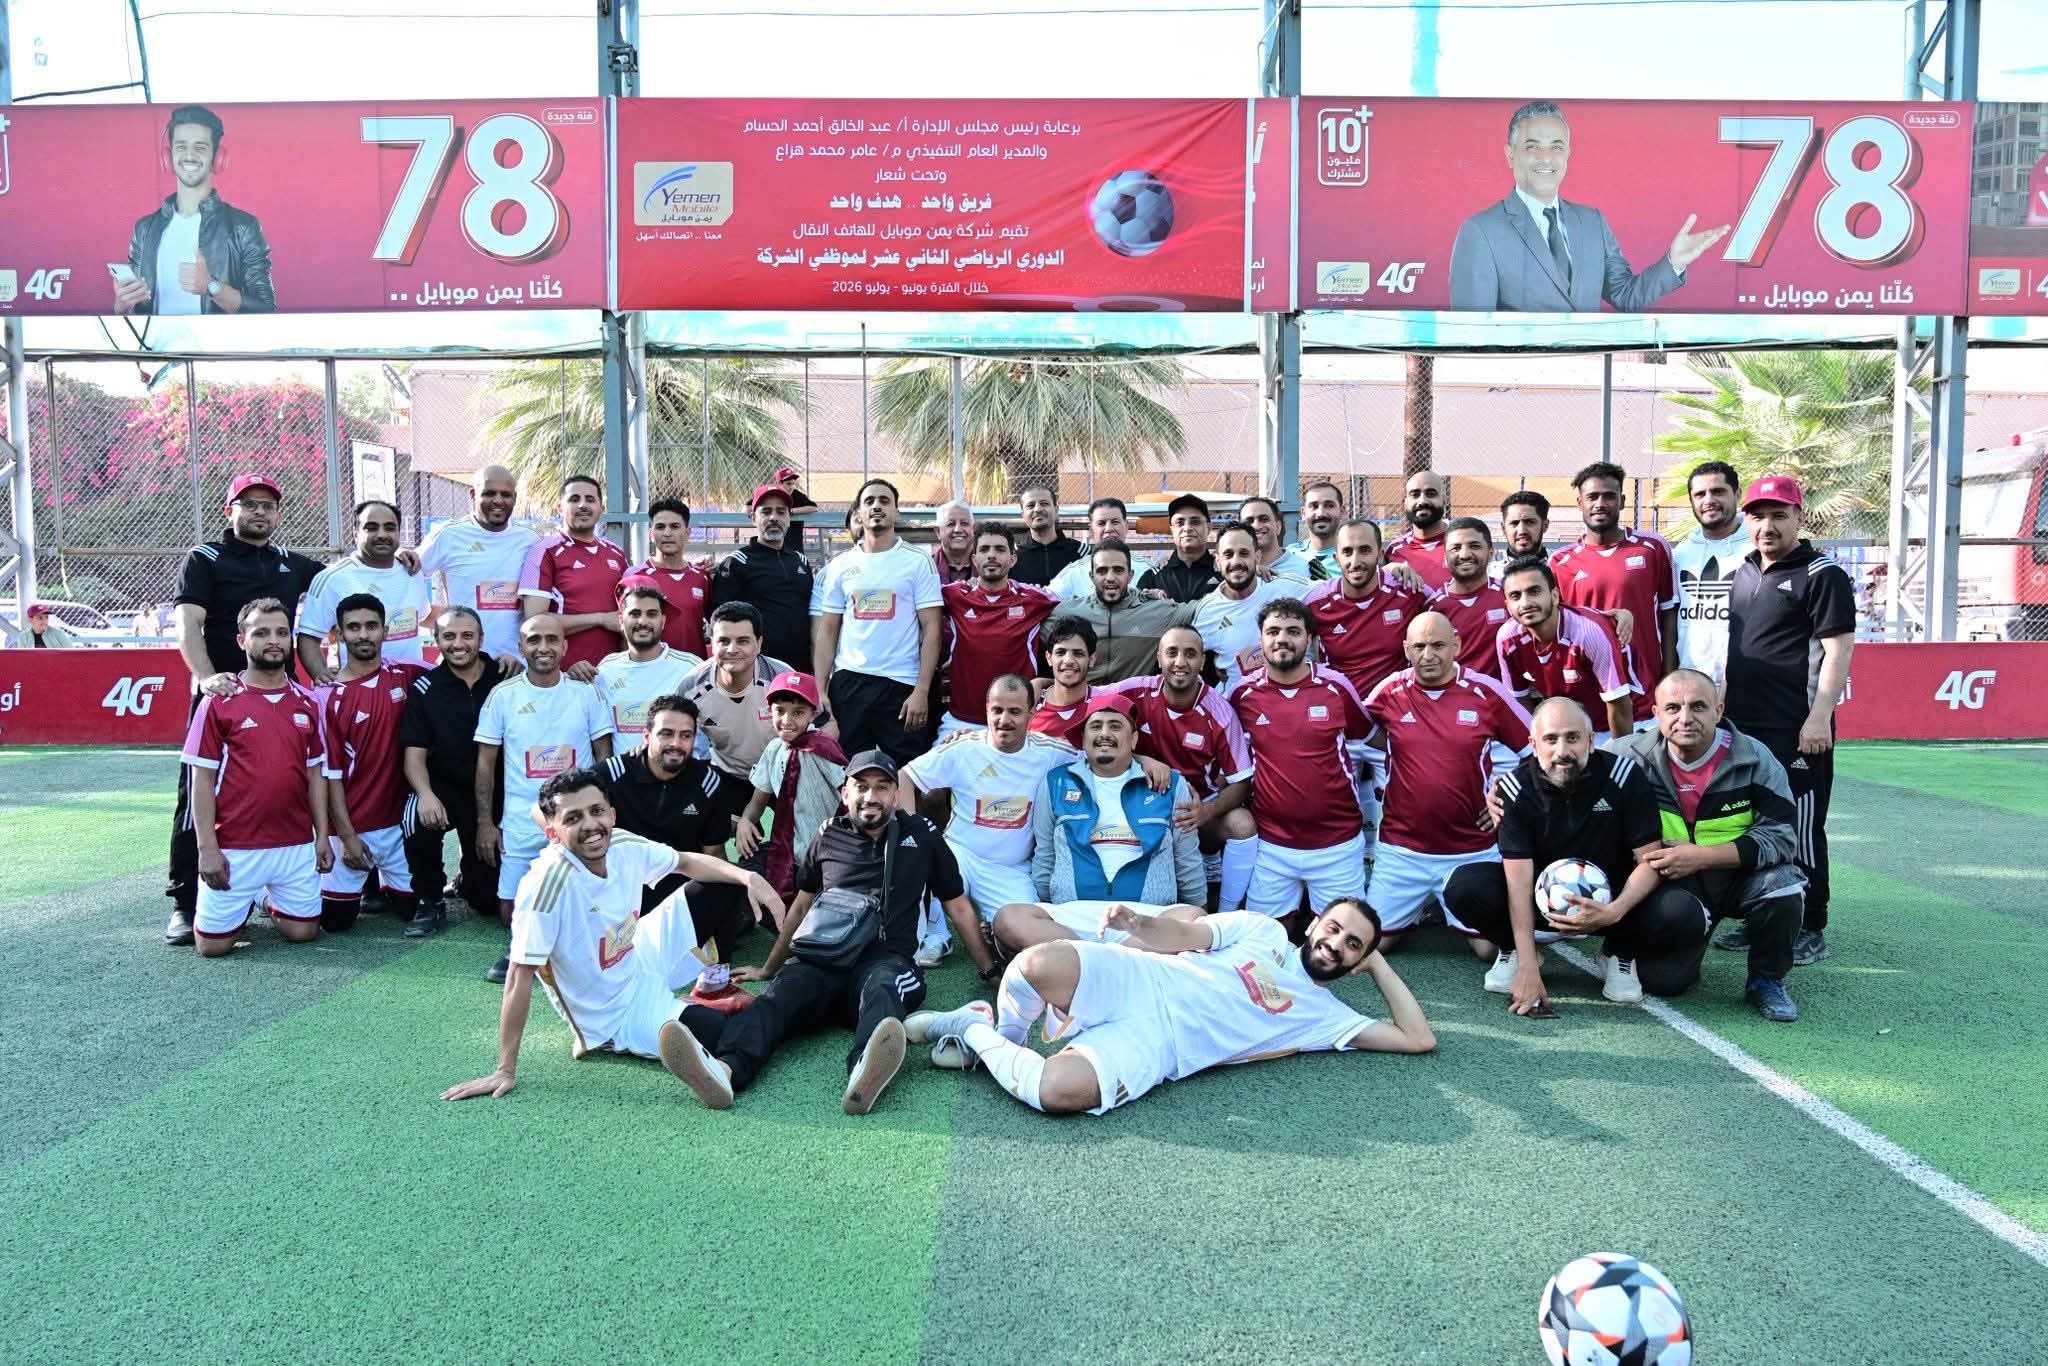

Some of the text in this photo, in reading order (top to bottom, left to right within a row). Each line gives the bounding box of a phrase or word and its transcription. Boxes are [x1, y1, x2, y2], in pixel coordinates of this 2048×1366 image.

[547, 111, 575, 123] جديدة
[792, 116, 824, 132] أحمد
[1909, 114, 1937, 126] جديدة
[743, 119, 788, 133] الحسام
[828, 119, 864, 135] الخالق
[868, 122, 892, 135] عبد
[912, 119, 951, 136] الإدارة
[955, 120, 999, 136] مجلس
[1003, 120, 1039, 136] رئيس
[1043, 120, 1081, 136] برعاية
[775, 143, 804, 161] هزاع
[809, 145, 845, 156] محمد
[849, 143, 878, 159] عامر
[906, 143, 961, 161] التنفيذي
[967, 143, 998, 158] العام
[1002, 143, 1047, 160] والمدير
[1327, 155, 1361, 167] مليون
[874, 166, 947, 184] وتحت شعار
[1327, 167, 1361, 180] مشترك
[360, 113, 560, 261] 78
[1718, 115, 1914, 264] 78
[662, 188, 721, 206] Yemen
[830, 193, 863, 212] واحد
[867, 193, 902, 208] هدف
[921, 193, 955, 212] واحد
[958, 193, 992, 212] فريق
[672, 205, 719, 213] Mobile
[661, 214, 694, 224] موبايل
[793, 222, 1030, 240] تقيم شركة يمن موبايل للهاتف النقال
[757, 247, 1064, 272] الدوري الرياضي الثاني عشر لموظفي الشركة
[24, 268, 71, 300] 4G
[1376, 263, 1426, 294] 4G
[415, 282, 479, 306] موبايل
[485, 285, 524, 305] يمن
[832, 281, 863, 293] 2026
[865, 281, 891, 296] يوليو
[901, 283, 927, 296] يونيو
[930, 281, 960, 295] الفترة
[963, 281, 989, 295] خلال
[1764, 284, 1828, 308] موبايل
[1835, 288, 1874, 309] يمن
[102, 676, 166, 716] 4G
[1934, 670, 1997, 710] 4G LTE
